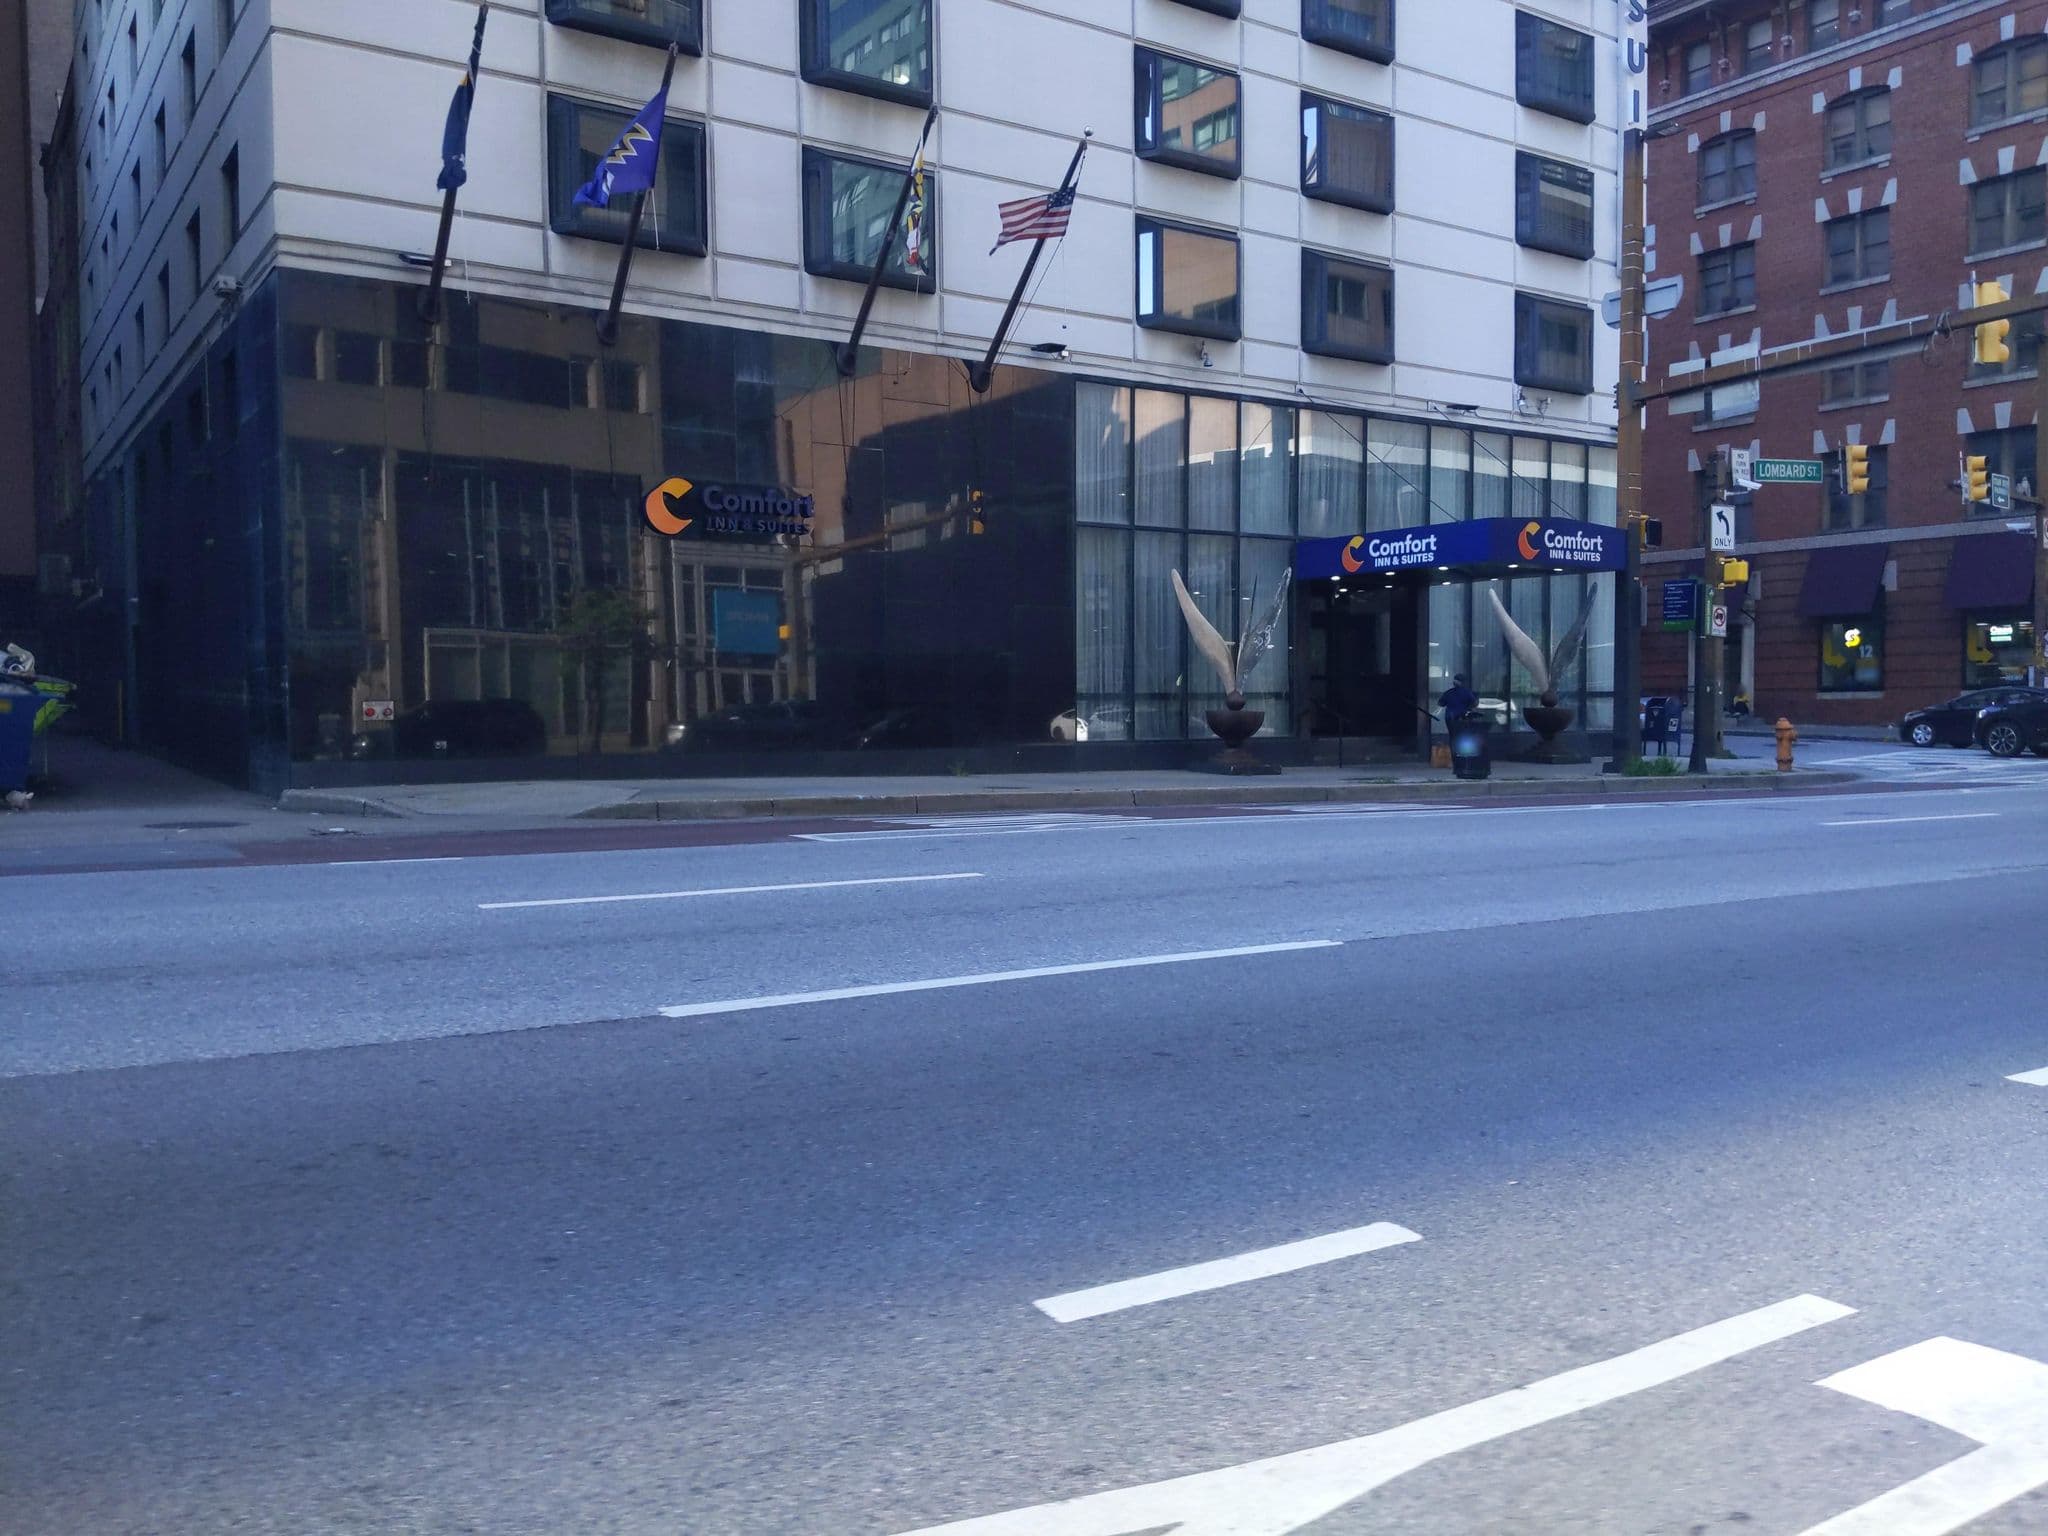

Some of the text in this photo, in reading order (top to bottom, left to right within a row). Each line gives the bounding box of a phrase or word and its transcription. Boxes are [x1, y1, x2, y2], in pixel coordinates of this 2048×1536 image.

[1759, 463, 1817, 478] LOMBARD ST
[703, 485, 815, 518] Comfort
[707, 516, 738, 531] INN
[1369, 534, 1437, 557] Comfort
[1544, 529, 1603, 551] Comfort
[1714, 537, 1731, 547] ONLY
[1374, 552, 1434, 567] INN & SUITES
[1549, 549, 1601, 562] INN & SUITES
